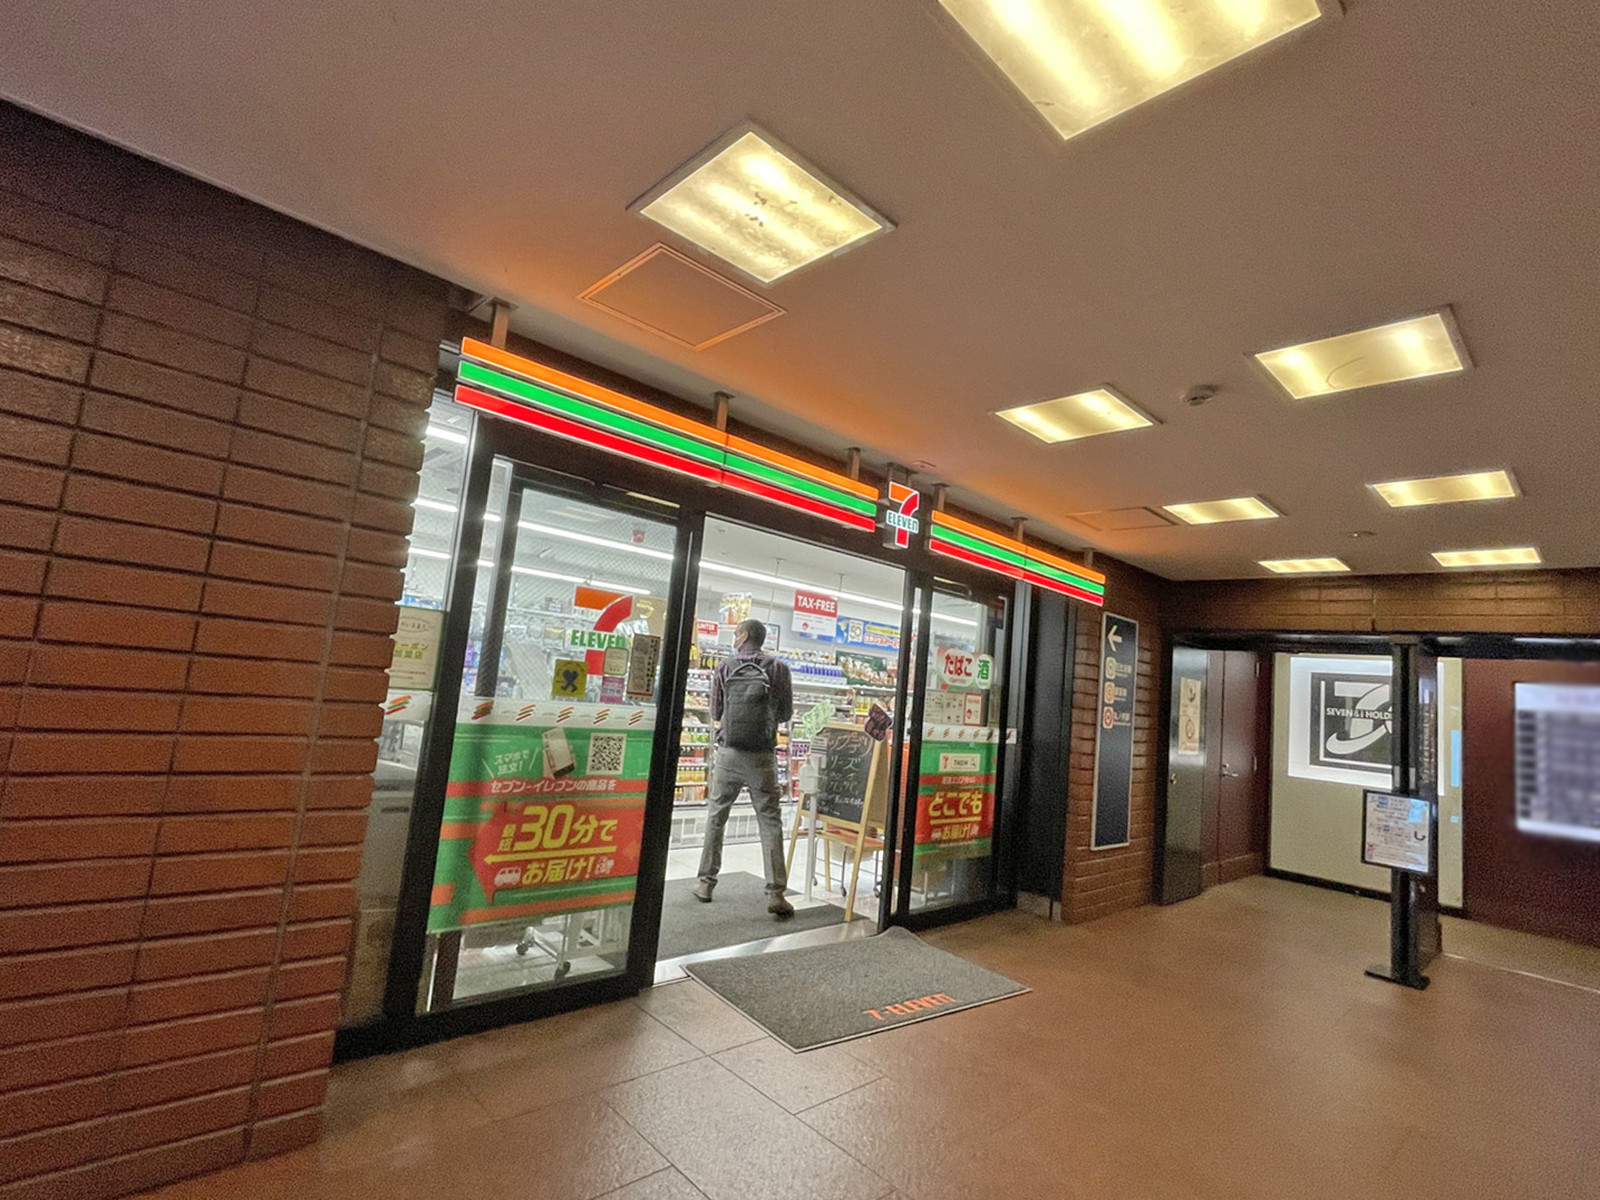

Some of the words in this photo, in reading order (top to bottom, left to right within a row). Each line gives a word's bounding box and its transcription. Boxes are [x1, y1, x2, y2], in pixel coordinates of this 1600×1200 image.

[944, 653, 973, 676] たばこ
[977, 659, 990, 680] 酒
[1365, 711, 1392, 720] HOLD
[929, 791, 983, 817] どこでも
